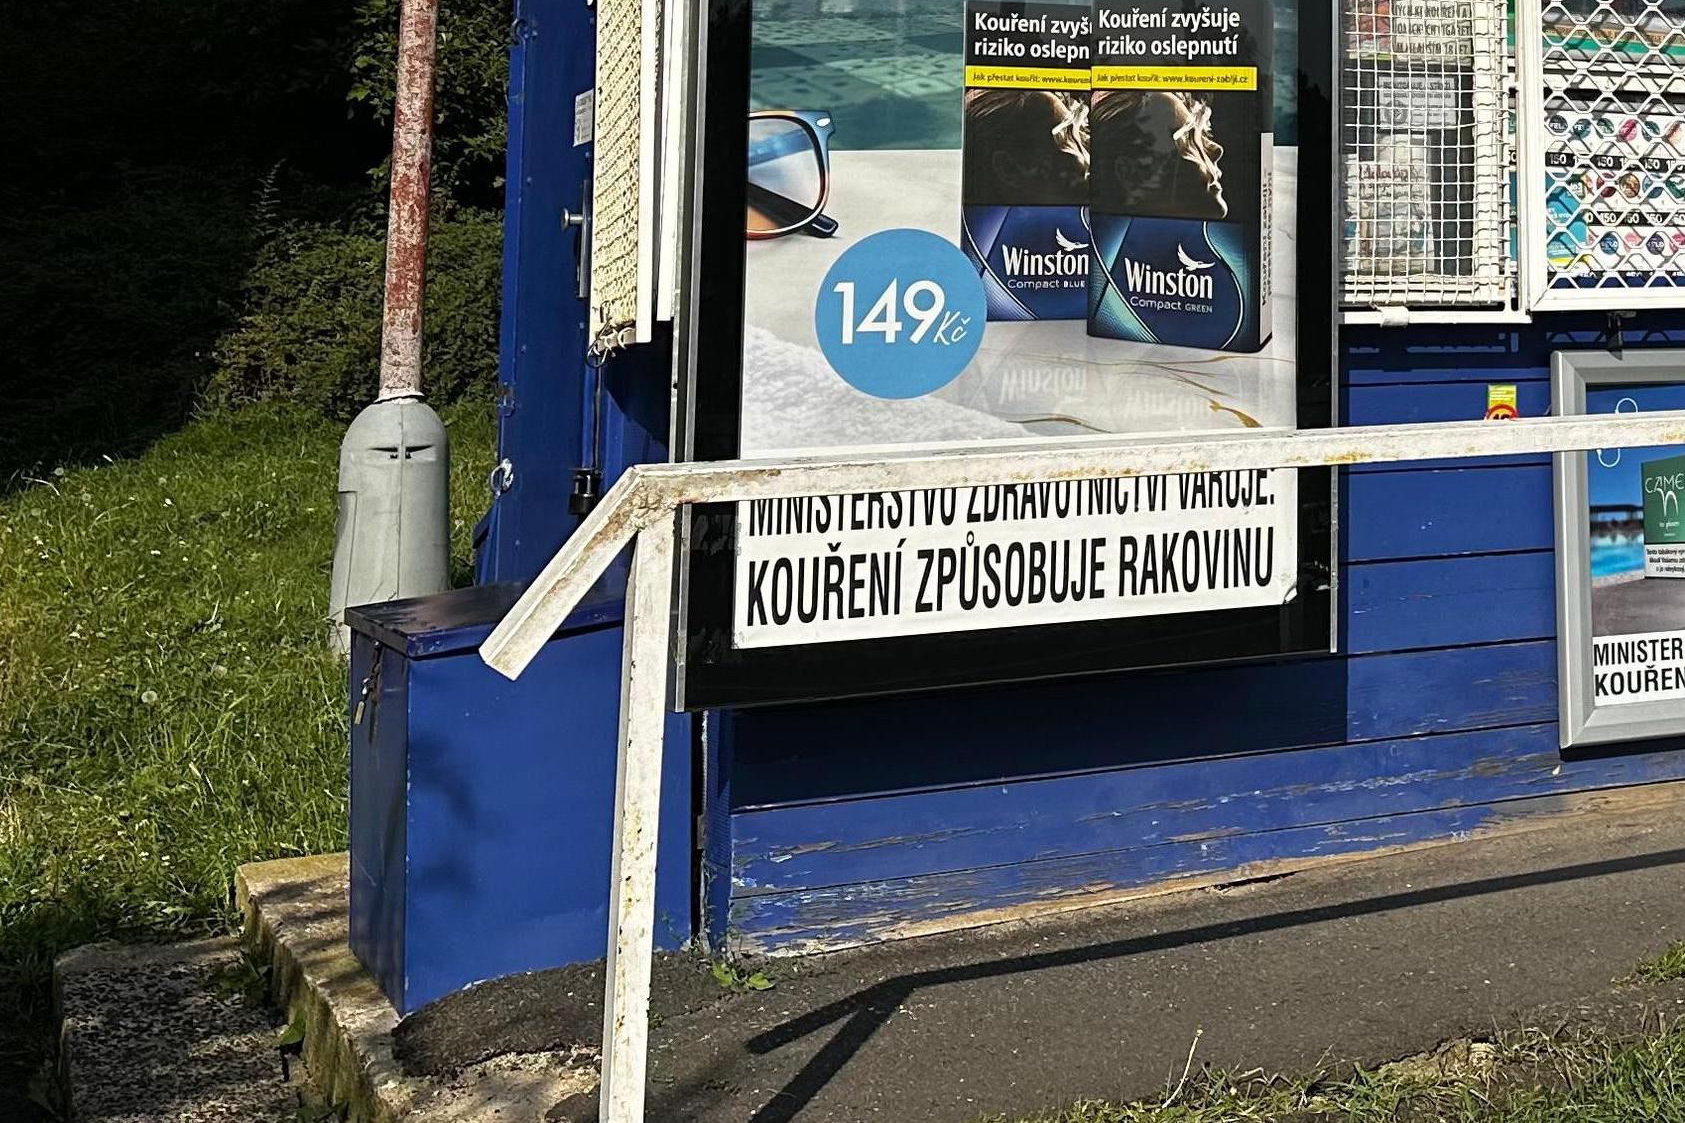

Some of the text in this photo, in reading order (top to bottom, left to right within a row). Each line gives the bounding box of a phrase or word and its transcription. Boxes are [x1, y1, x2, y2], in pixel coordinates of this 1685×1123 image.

[974, 12, 1046, 33] Kouření
[1099, 7, 1240, 34] Kouření zvyšuje
[974, 37, 1025, 57] riziko
[1098, 34, 1238, 60] riziko oslepnutí
[1002, 244, 1089, 276] Winston
[1007, 279, 1059, 291] Compact
[1124, 257, 1213, 299] Winston
[833, 277, 947, 345] 149
[1130, 296, 1213, 313] Compact GREEN
[747, 526, 1274, 626] KOUŘENÍ ZPŮSOBUJE RAKOVINU
